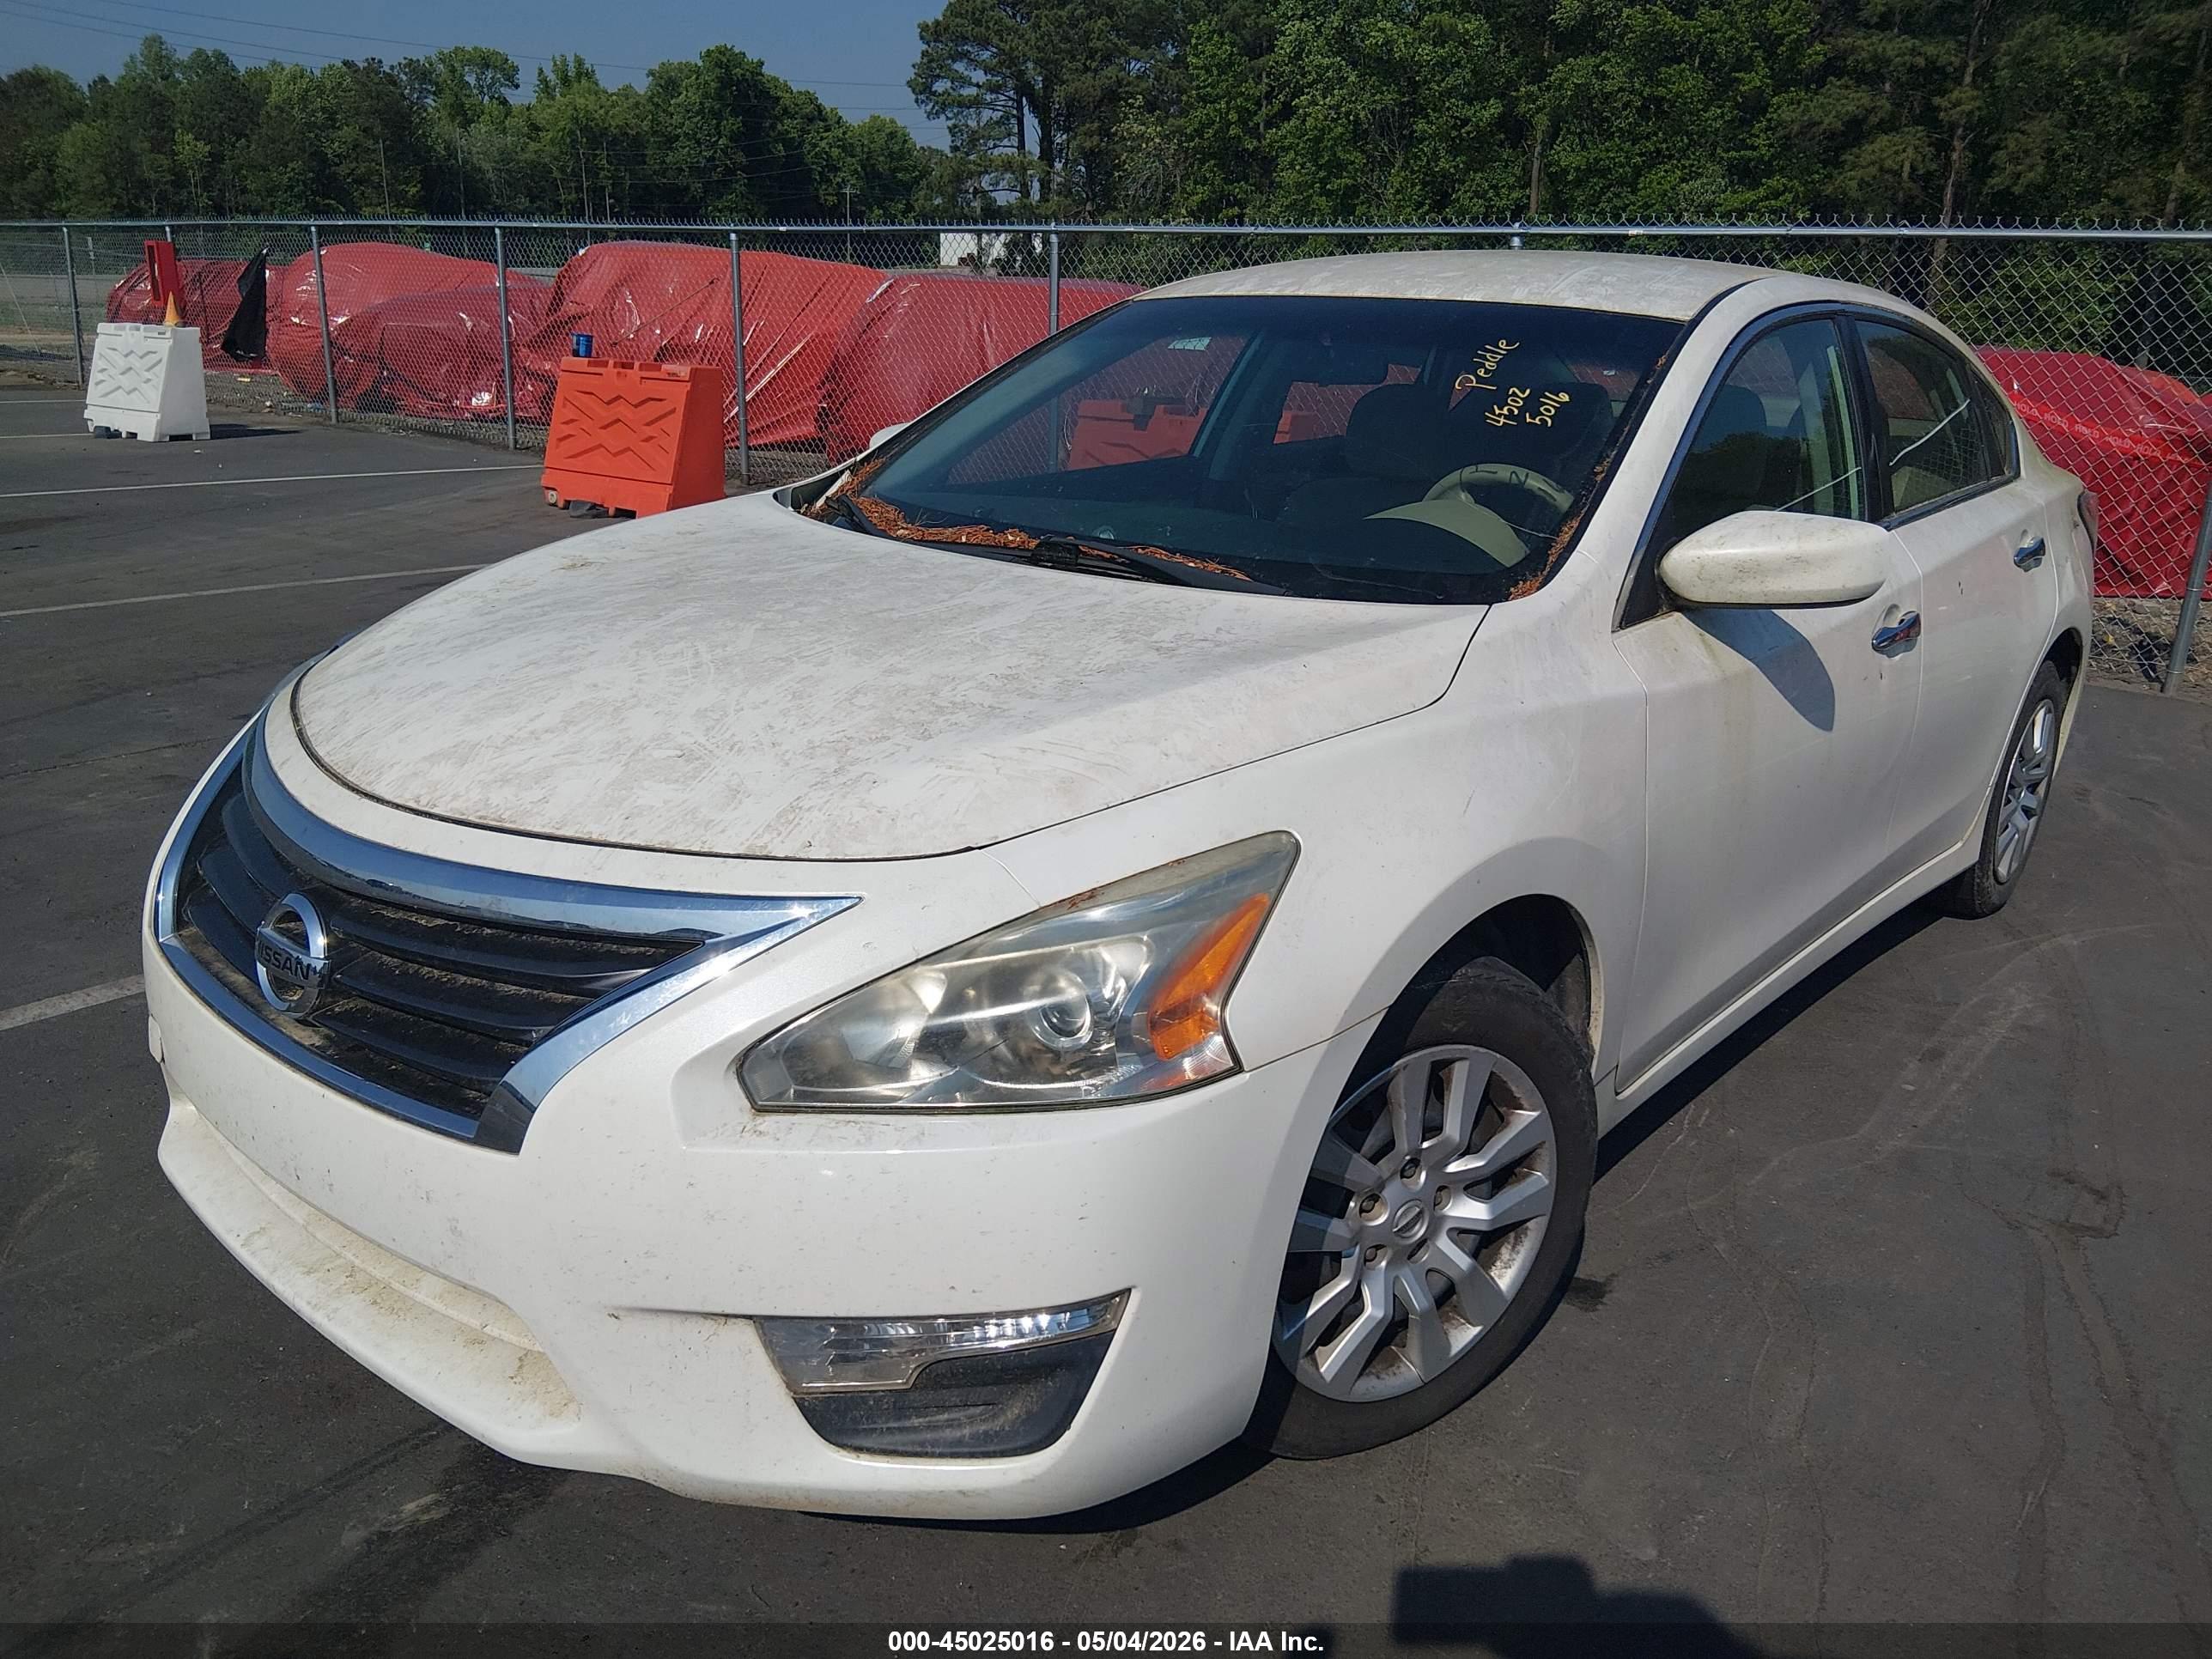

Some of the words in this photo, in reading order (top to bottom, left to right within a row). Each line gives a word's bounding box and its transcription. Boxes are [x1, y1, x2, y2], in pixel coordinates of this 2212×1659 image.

[1455, 339, 1520, 389] Peddle
[1485, 387, 1530, 425] 4502
[1526, 392, 1570, 427] 5016
[2045, 411, 2068, 428] HOLD
[2075, 422, 2099, 438] HOLD
